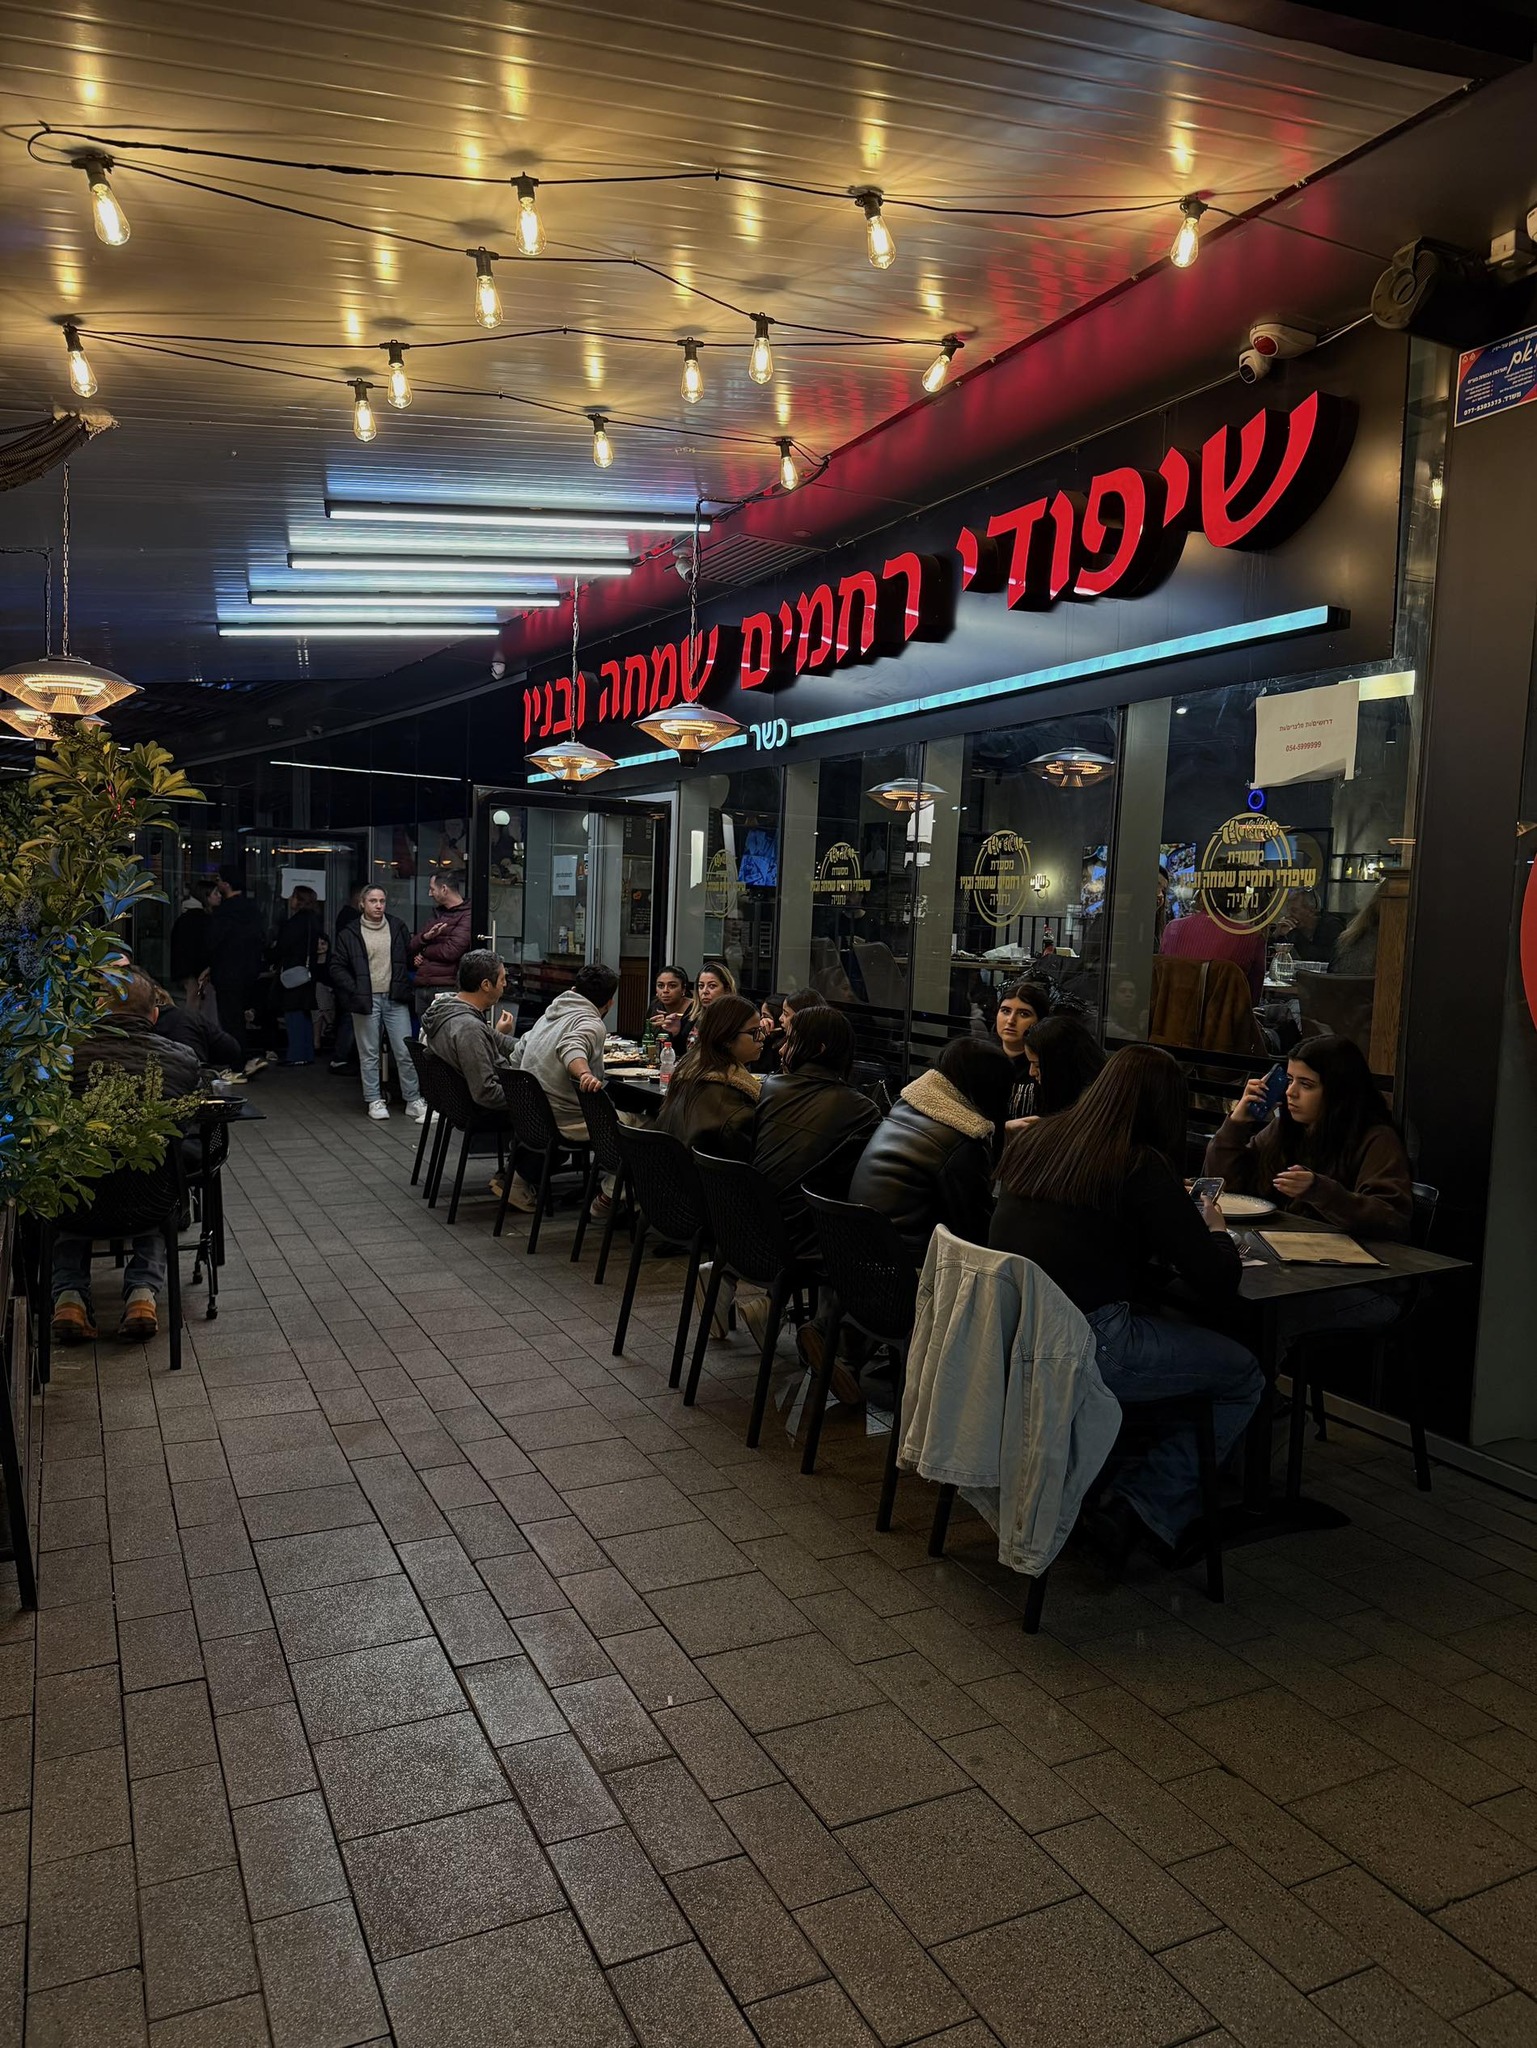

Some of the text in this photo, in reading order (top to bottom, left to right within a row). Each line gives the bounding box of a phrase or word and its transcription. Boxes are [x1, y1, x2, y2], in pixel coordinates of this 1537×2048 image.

[523, 391, 1318, 743] שיפודי רחמים שמחה ובנין
[750, 718, 788, 750] כשר
[1202, 870, 1236, 888] שמחה
[1238, 869, 1273, 888] רחמים
[1276, 868, 1317, 887] שיפודי
